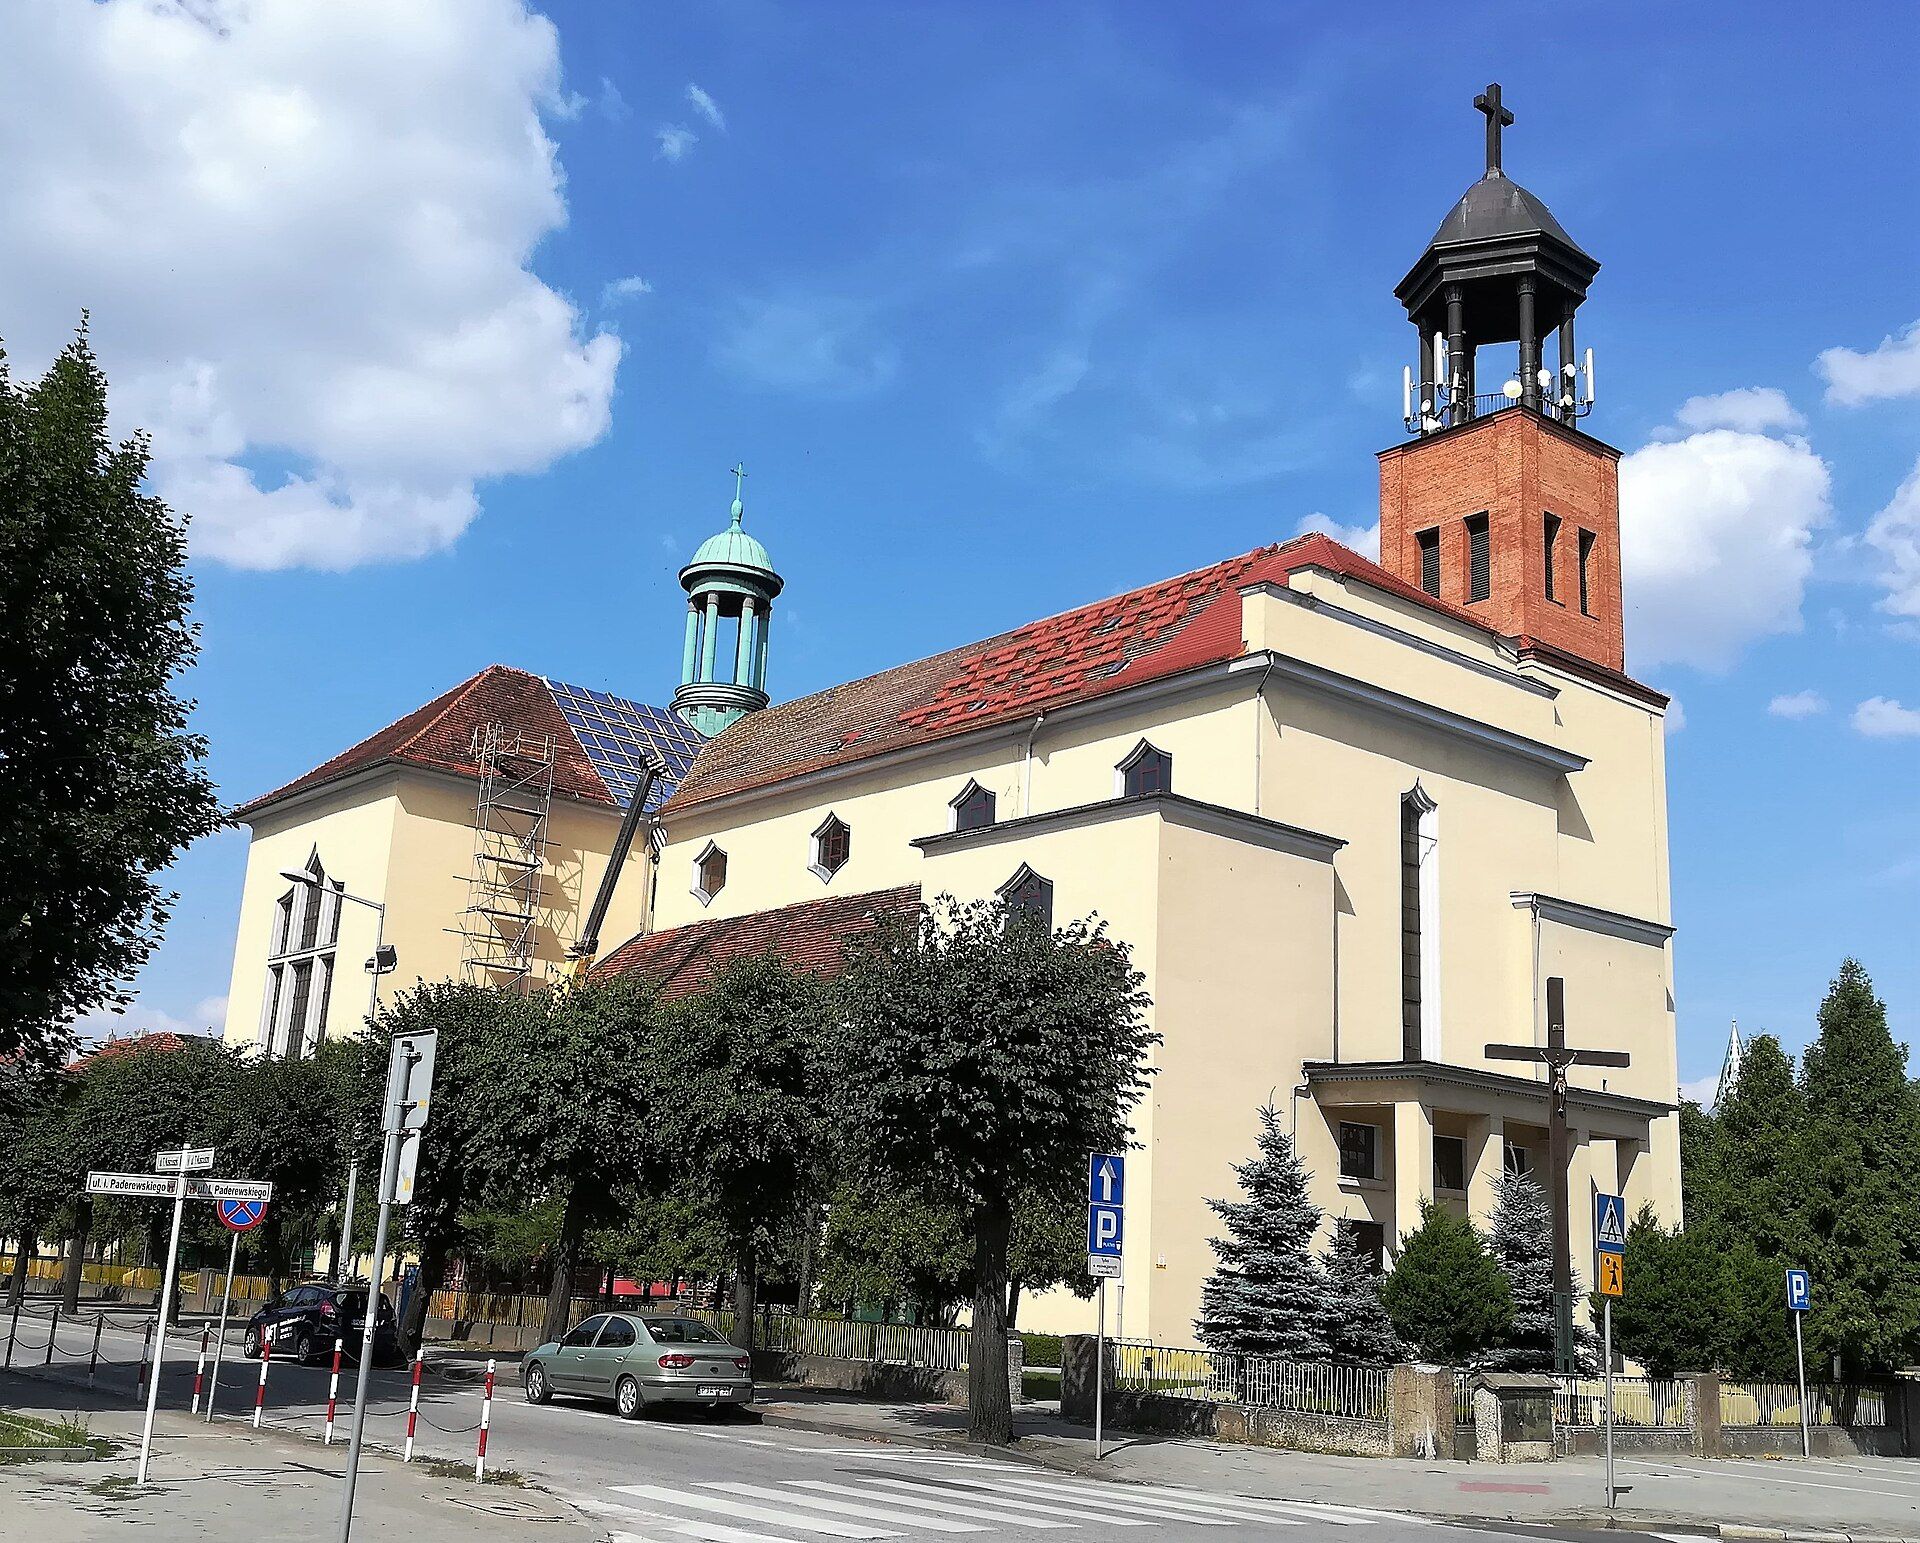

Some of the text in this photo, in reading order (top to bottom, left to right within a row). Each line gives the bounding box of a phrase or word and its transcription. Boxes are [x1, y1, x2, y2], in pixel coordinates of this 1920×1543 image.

[92, 1178, 102, 1188] ul.
[110, 1178, 167, 1194] Paderewskiego
[214, 1185, 267, 1199] Paderewskiego
[1097, 1210, 1117, 1249] P
[1791, 1274, 1805, 1304] P
